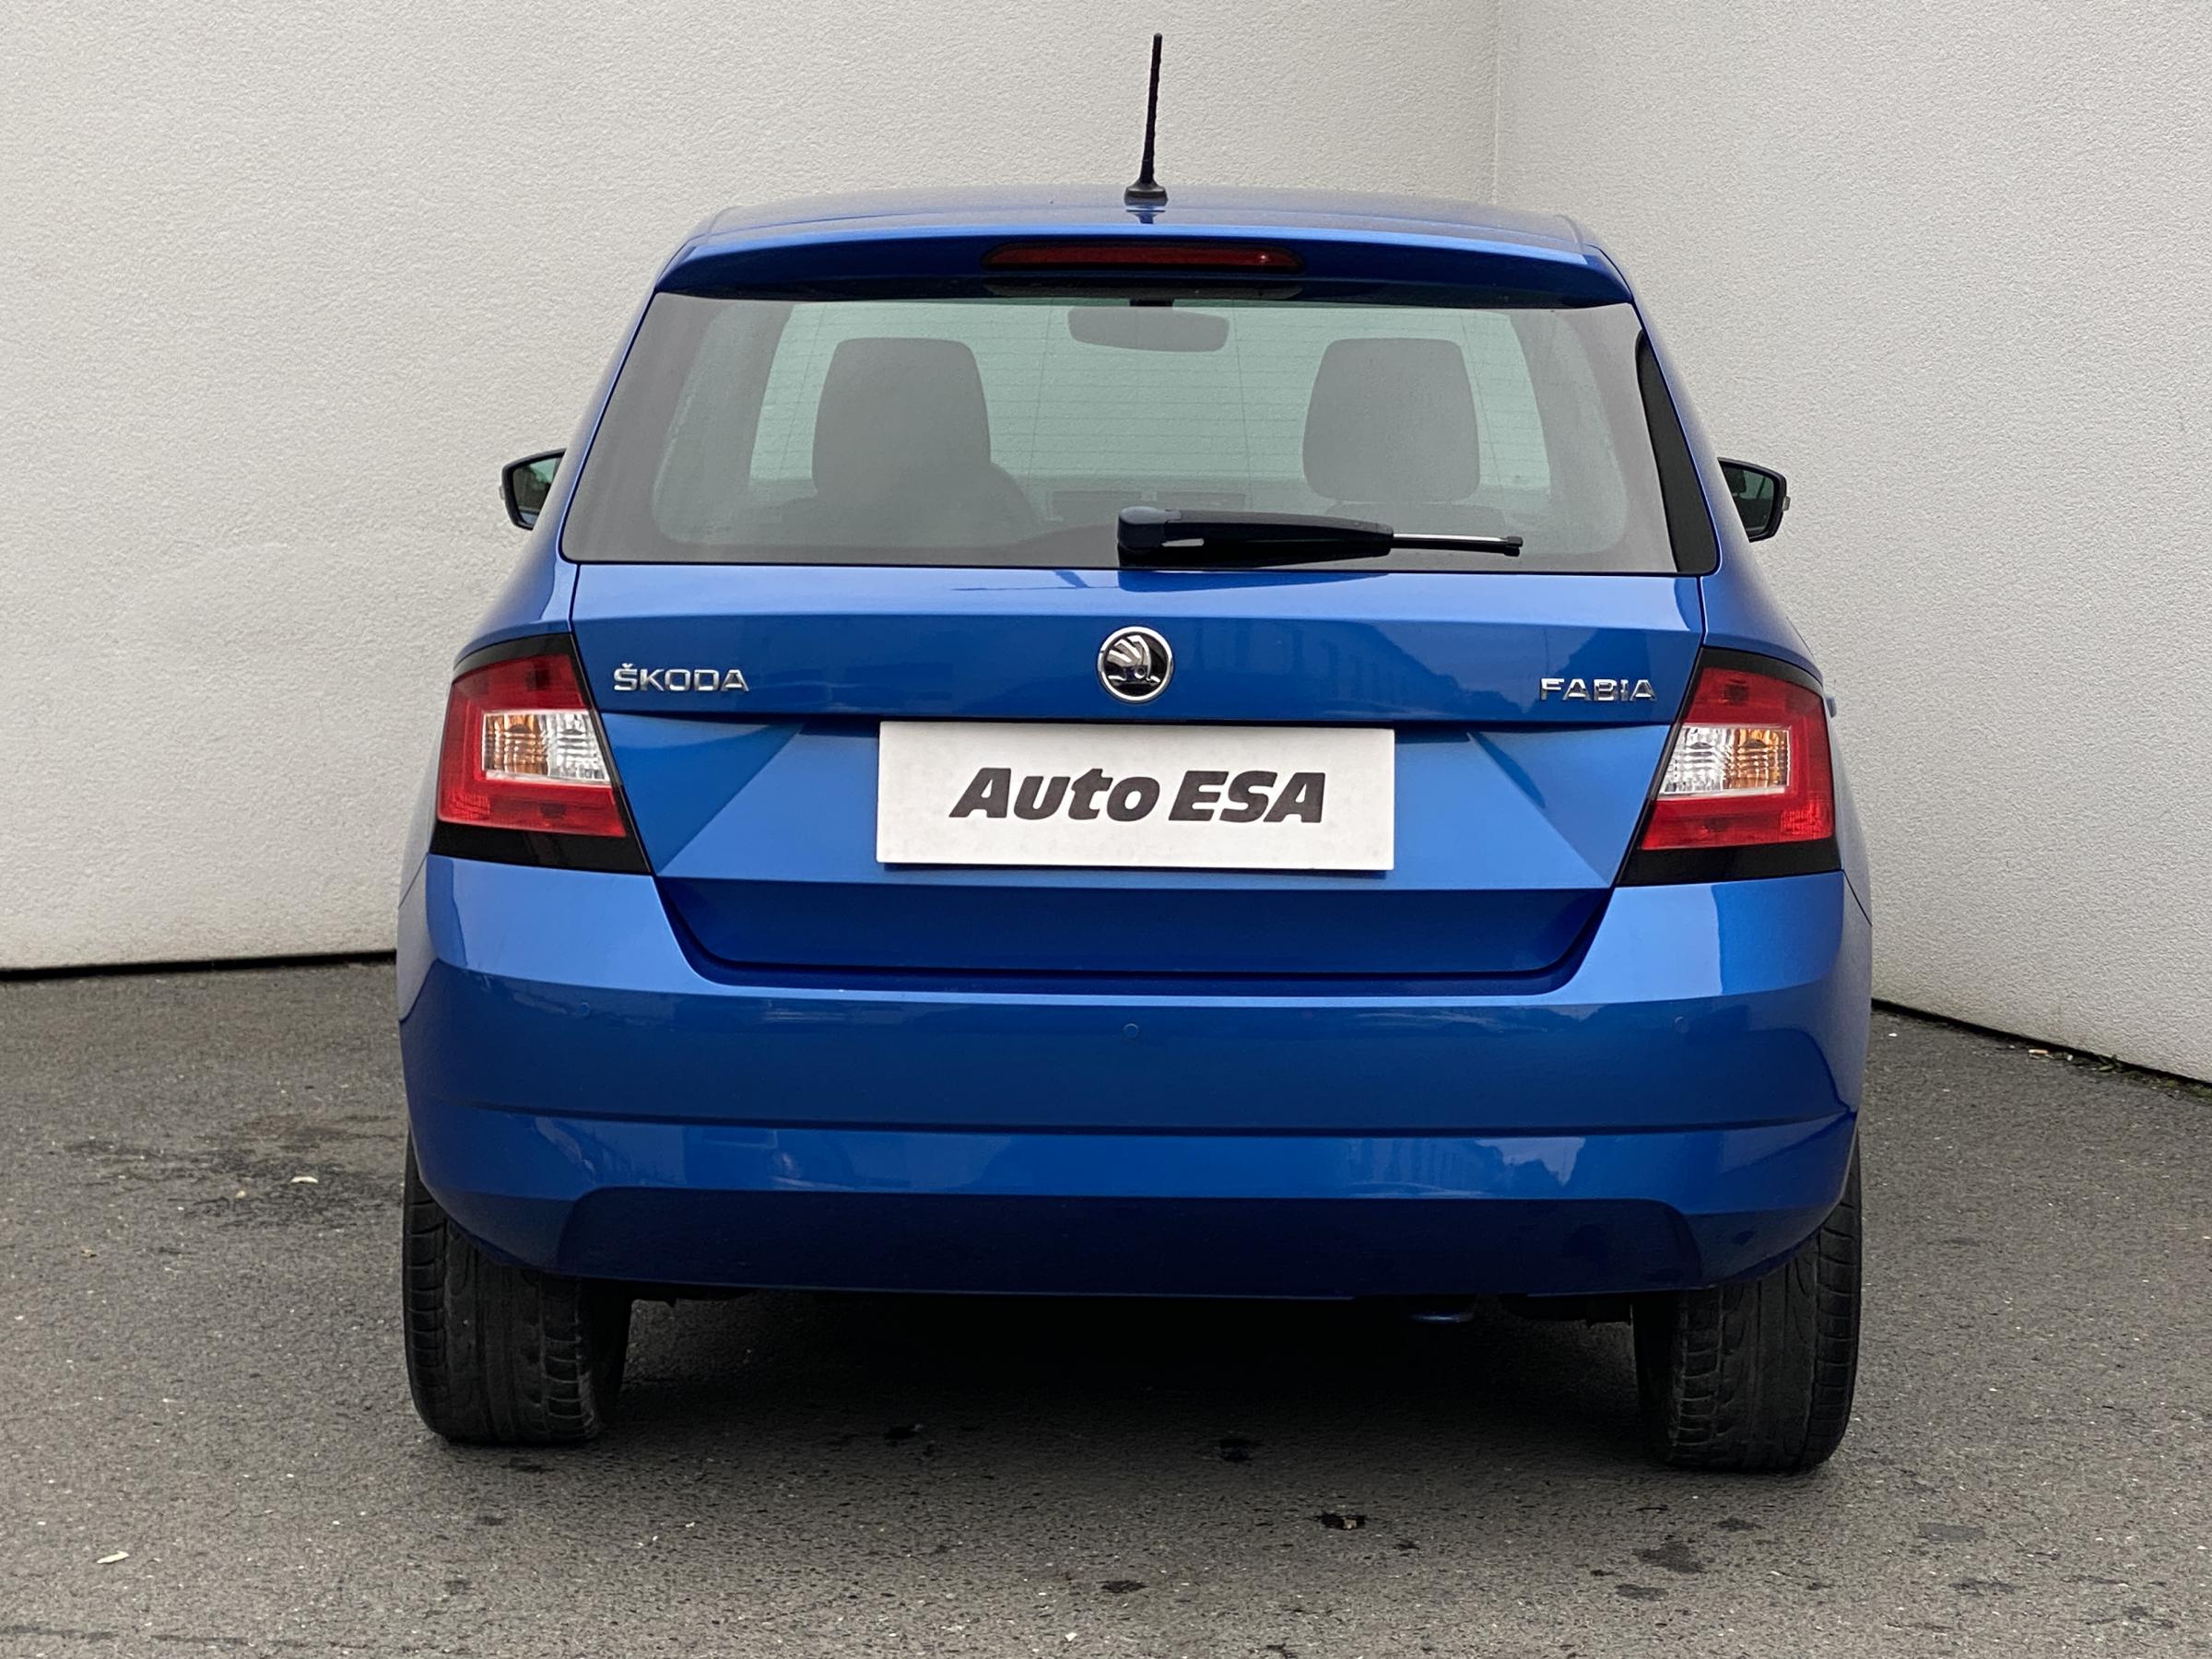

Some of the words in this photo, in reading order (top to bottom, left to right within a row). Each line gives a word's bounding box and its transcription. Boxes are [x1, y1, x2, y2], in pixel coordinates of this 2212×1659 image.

[614, 663, 749, 691] ŠKODA
[1540, 677, 1657, 701] FABIA
[948, 767, 1160, 822] Auto
[1168, 770, 1325, 823] ESA
